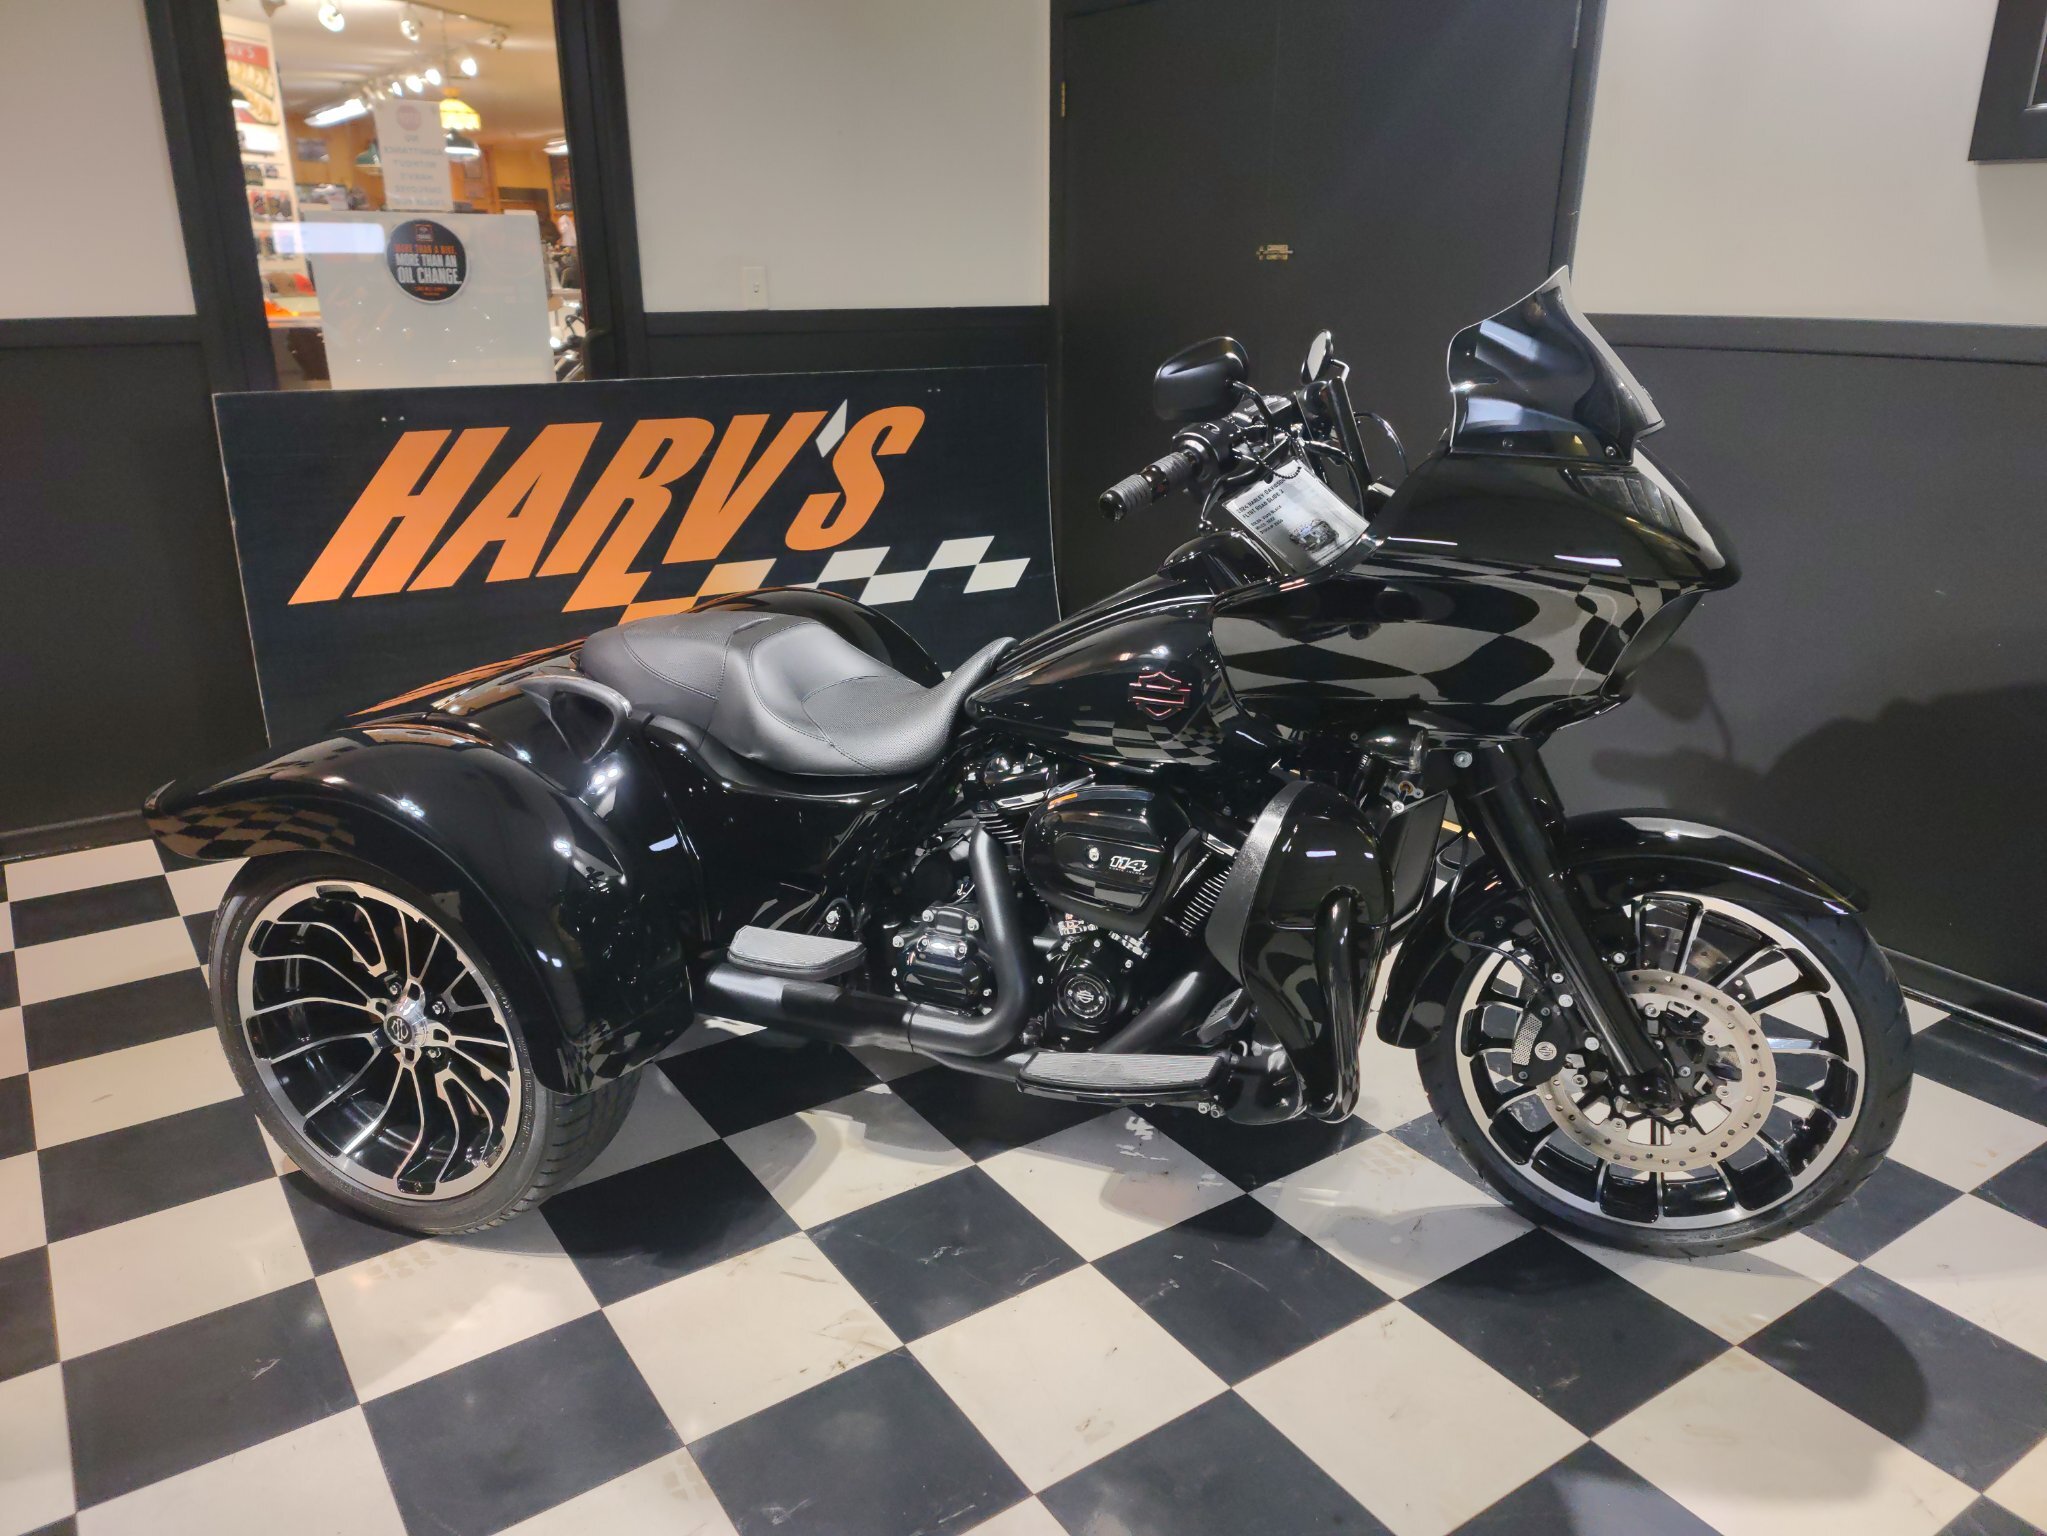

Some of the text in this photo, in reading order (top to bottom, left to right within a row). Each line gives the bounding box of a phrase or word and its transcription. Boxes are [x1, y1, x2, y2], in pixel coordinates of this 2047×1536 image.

[395, 253, 457, 267] MORE THAN AN
[397, 267, 463, 285] OIL CHANGE.
[289, 400, 925, 612] HARV'S
[1266, 493, 1280, 503] GLIDE
[1110, 855, 1148, 871] 114
